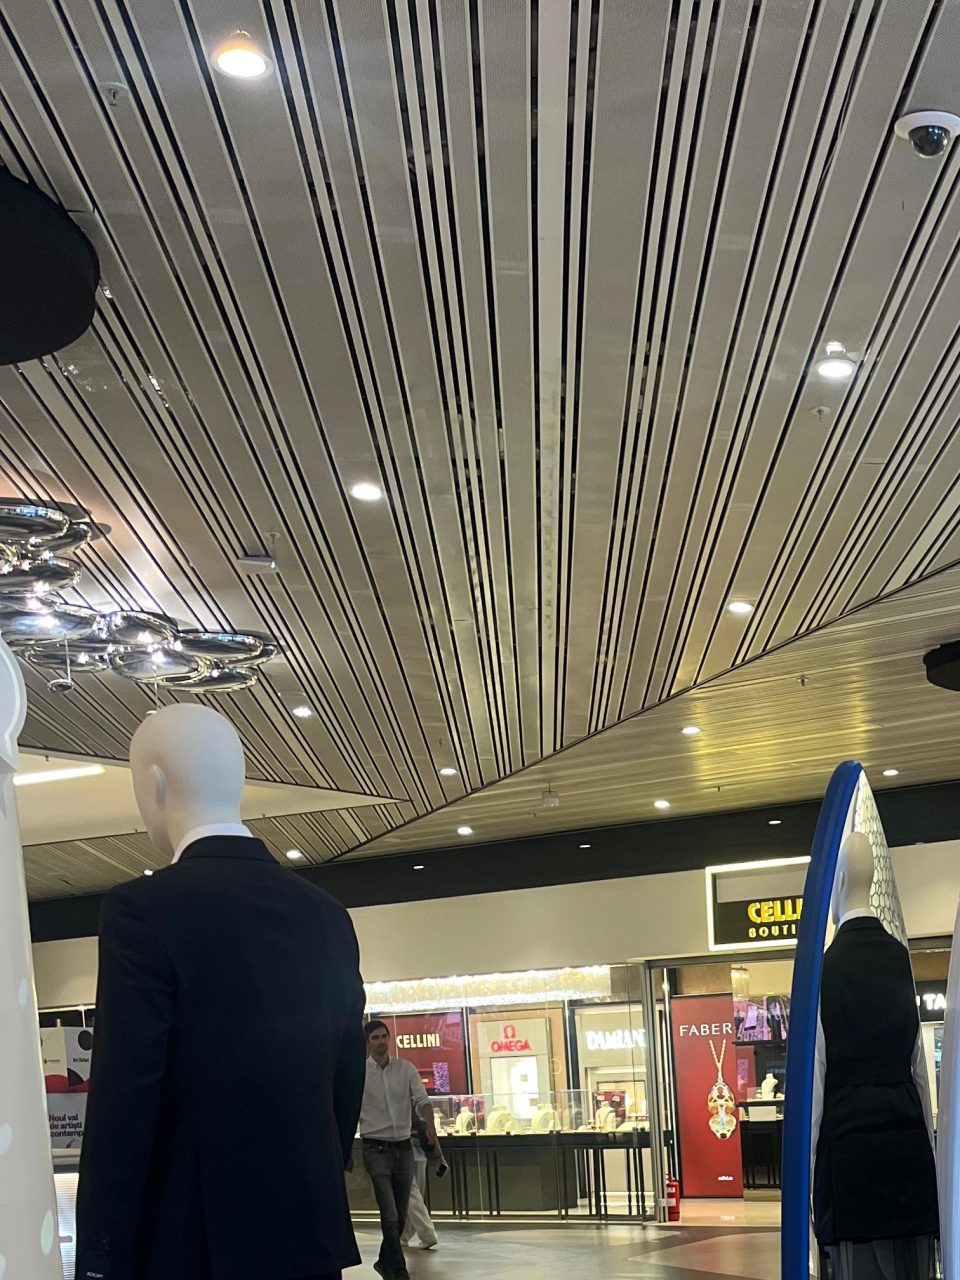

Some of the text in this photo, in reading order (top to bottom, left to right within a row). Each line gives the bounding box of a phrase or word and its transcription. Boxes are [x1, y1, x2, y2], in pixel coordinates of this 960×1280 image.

[679, 1022, 733, 1037] FABER
[396, 1032, 441, 1049] CELLINI
[491, 1039, 532, 1053] OMEGA
[49, 1113, 79, 1122] Noul val
[49, 1122, 59, 1130] de
